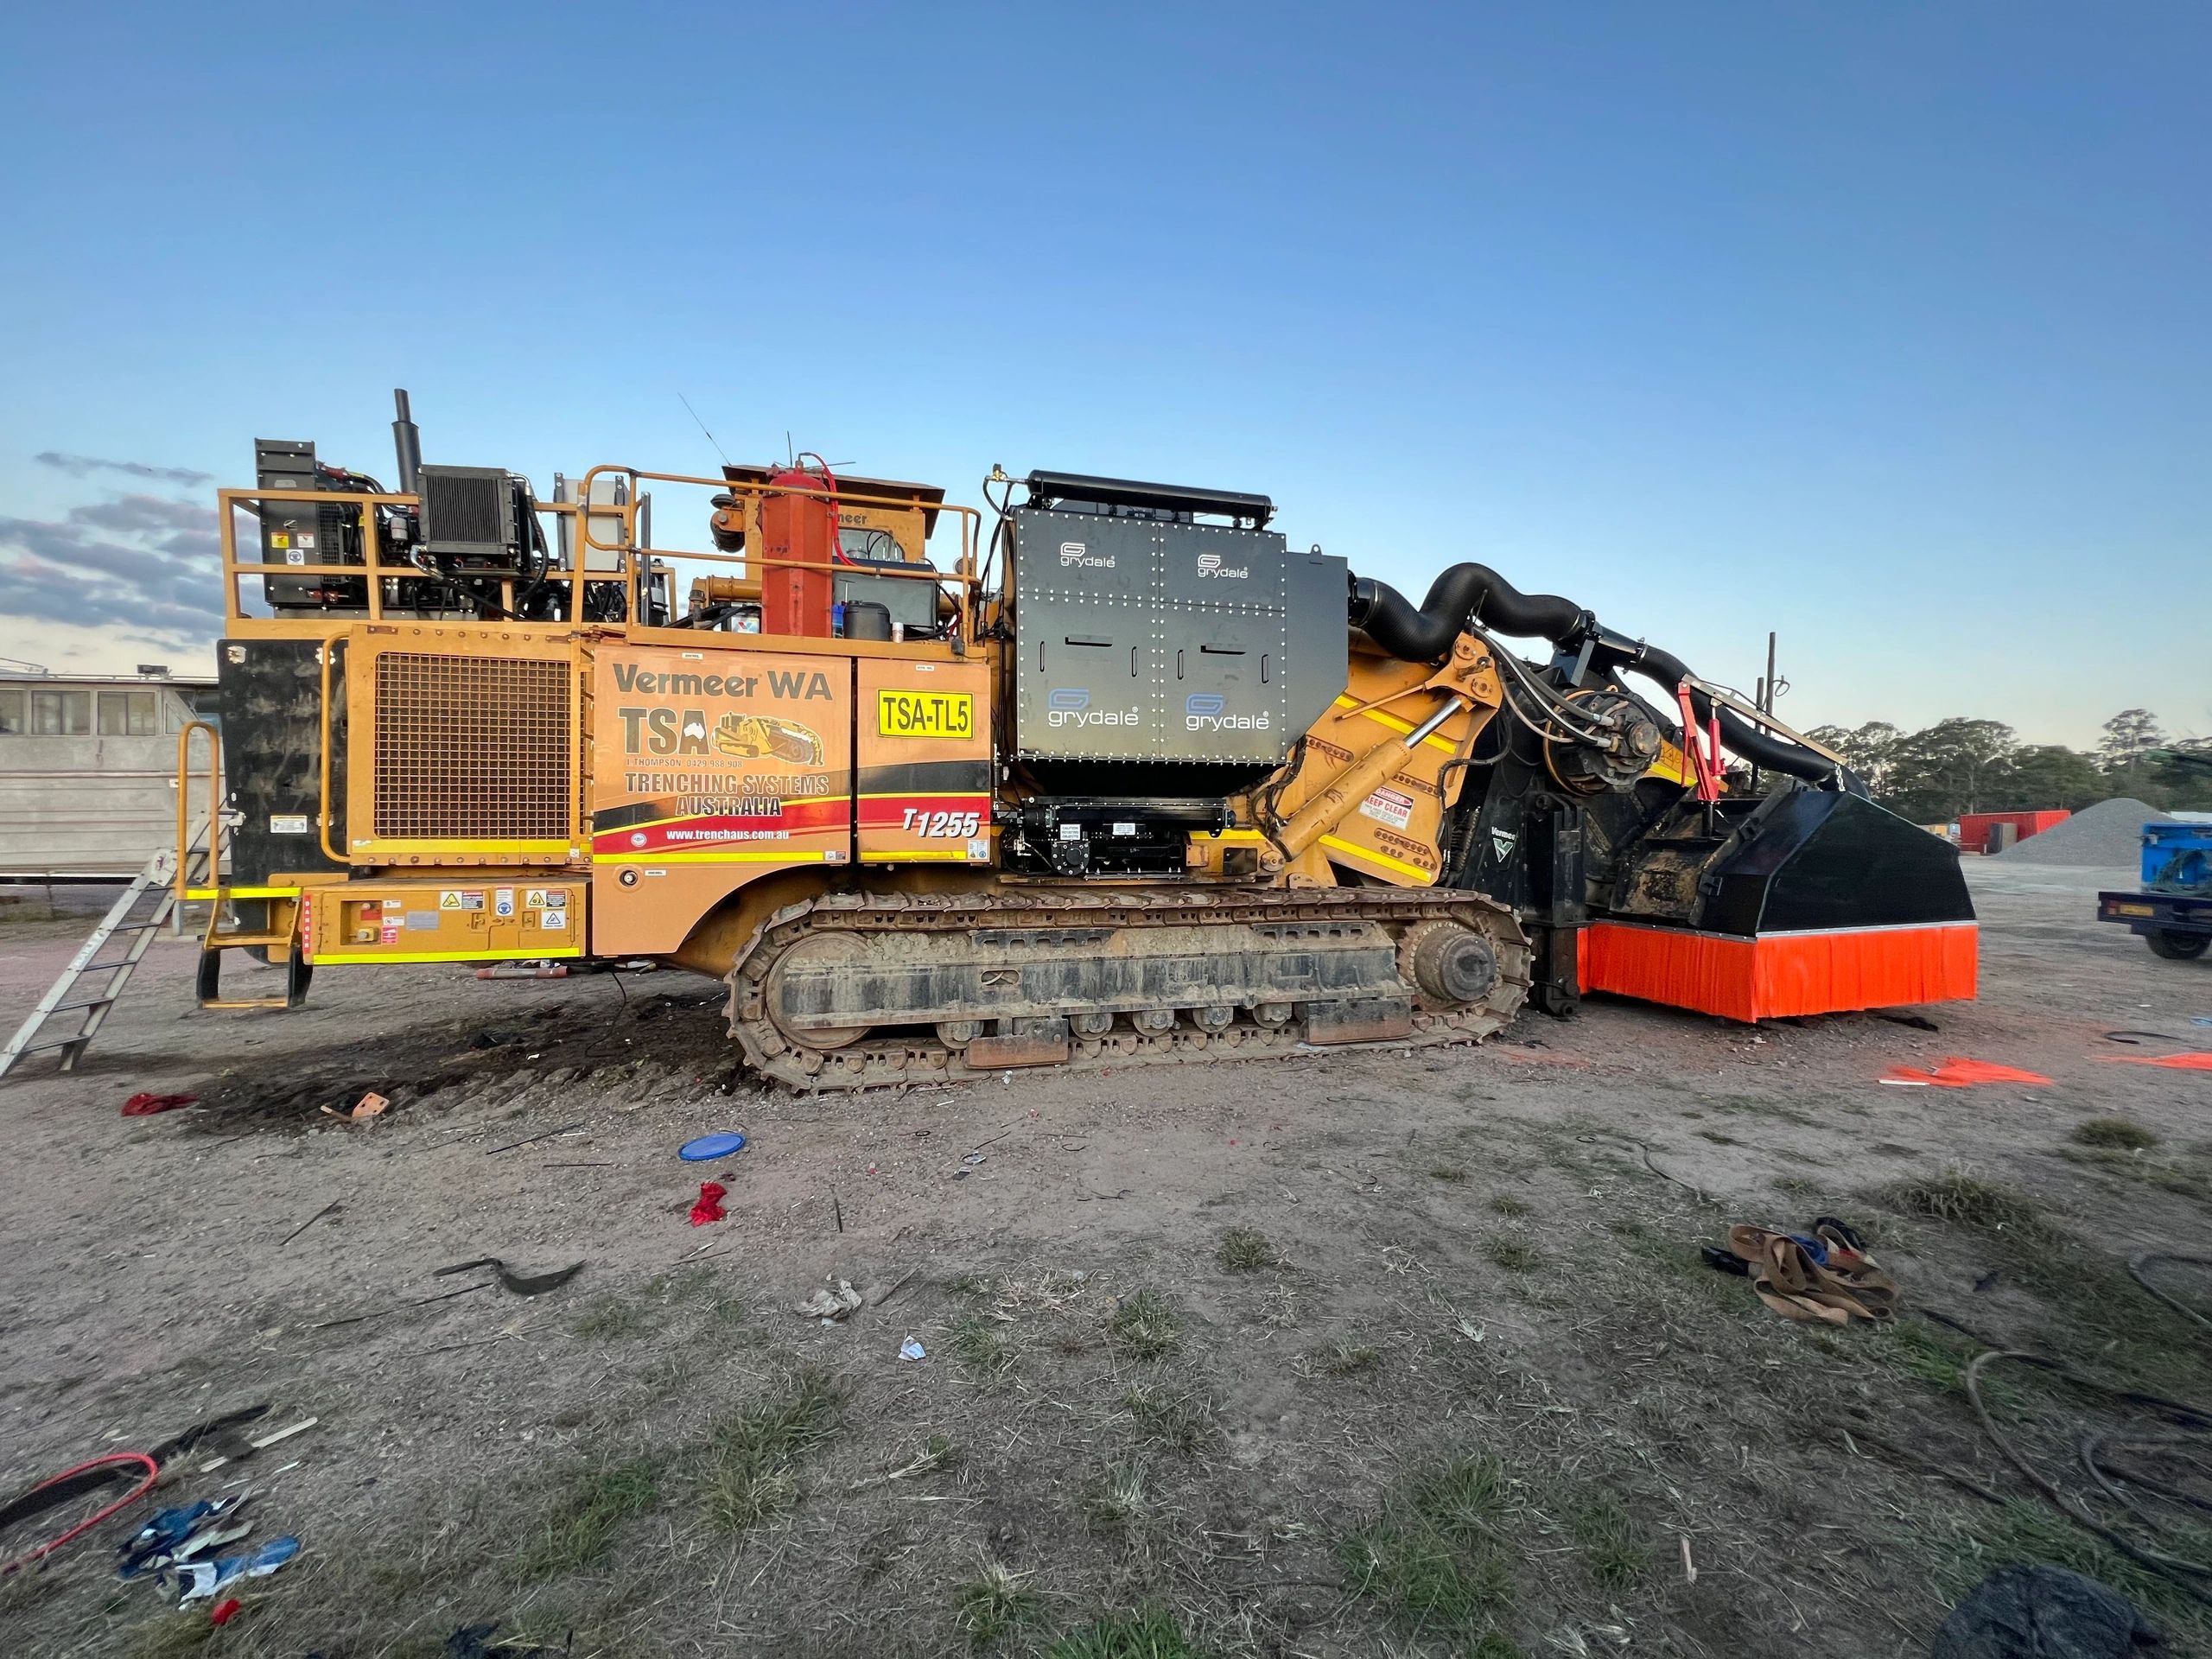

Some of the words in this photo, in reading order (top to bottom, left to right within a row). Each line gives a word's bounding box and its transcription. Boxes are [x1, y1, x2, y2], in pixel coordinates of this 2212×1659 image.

[612, 664, 758, 697] Vermeer
[767, 671, 833, 701] WA
[883, 696, 969, 732] TSA-TL5
[618, 707, 710, 755] TSA
[625, 772, 737, 795] TRENCHING
[741, 775, 830, 796] SYSTEMS
[675, 796, 782, 817] AUSTRALIA
[1384, 804, 1408, 817] CLEAR
[666, 830, 790, 841] www.trenchaus.com.au
[903, 808, 982, 838] T1255
